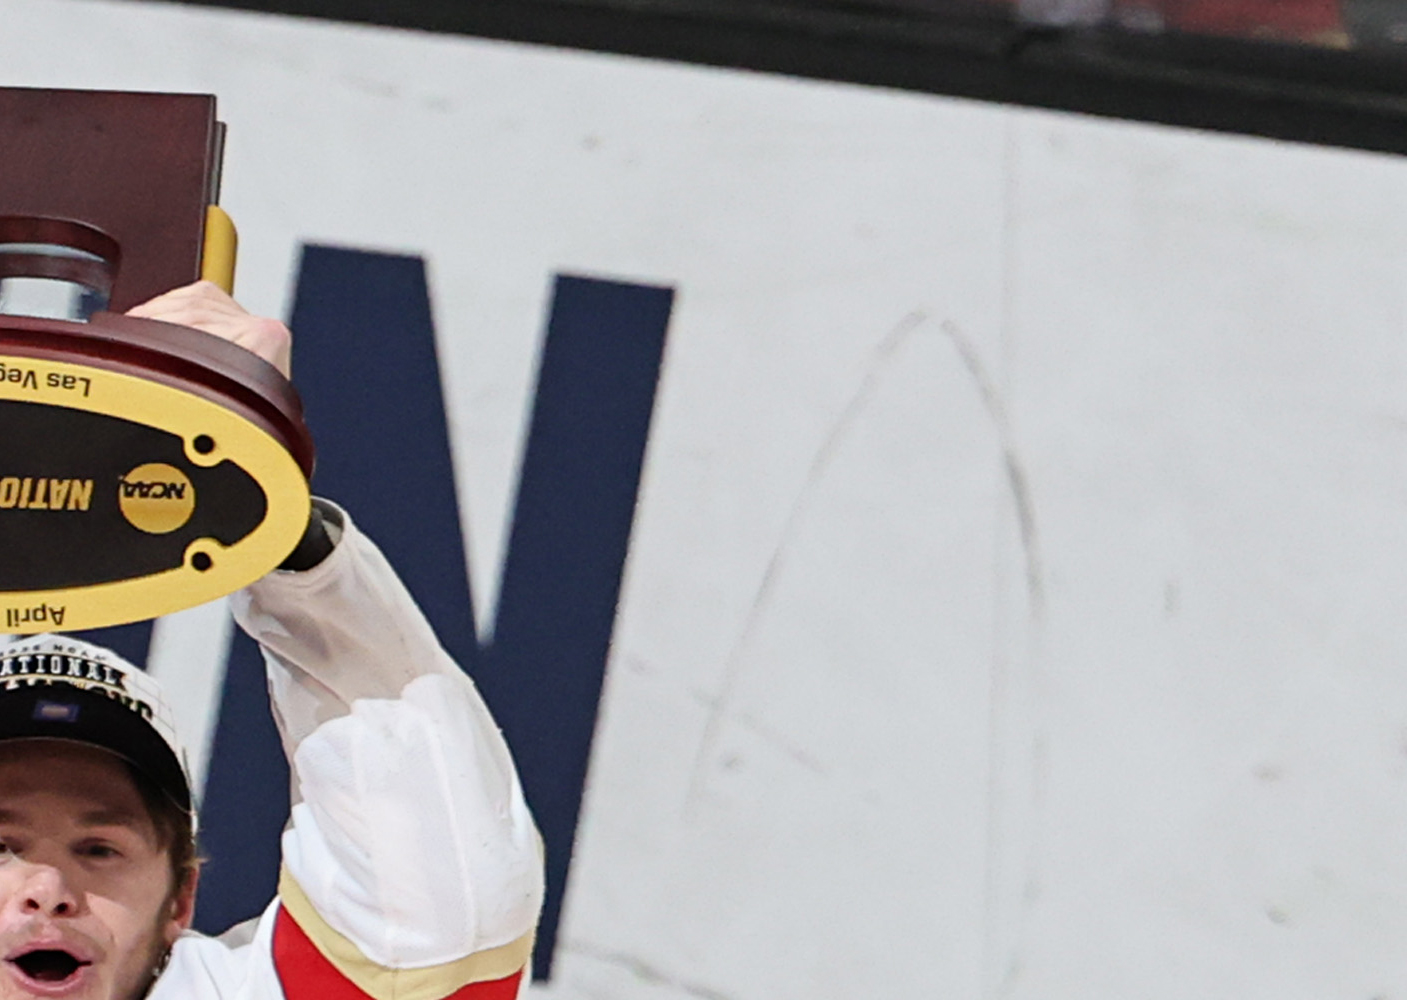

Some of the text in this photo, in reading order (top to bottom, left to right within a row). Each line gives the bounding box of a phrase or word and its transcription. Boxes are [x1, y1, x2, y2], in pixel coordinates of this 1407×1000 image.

[47, 372, 91, 397] Las
[121, 480, 186, 500] NCAA
[7, 603, 65, 628] April
